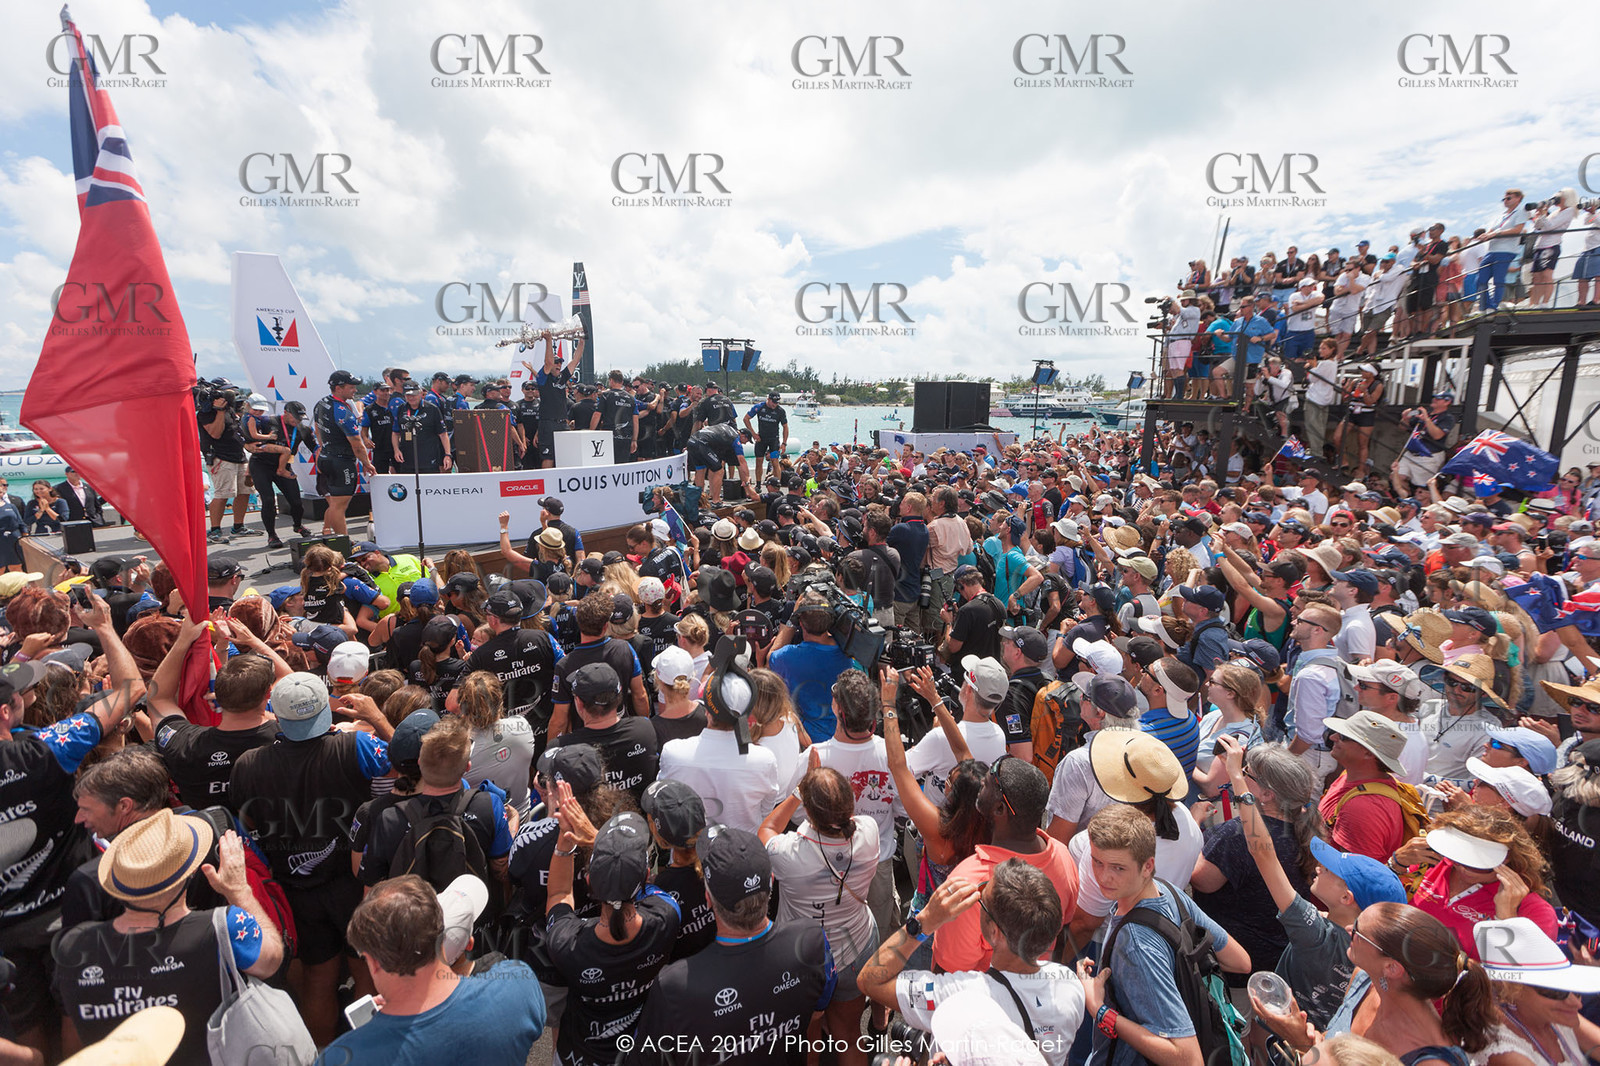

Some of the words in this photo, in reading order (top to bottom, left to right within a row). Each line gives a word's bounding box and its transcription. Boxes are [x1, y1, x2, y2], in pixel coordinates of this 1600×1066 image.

[0, 455, 63, 466] UDA
[559, 475, 607, 493] LOUIS
[612, 468, 661, 486] VUITTON
[426, 487, 484, 496] PANERAI
[512, 660, 524, 669] Fly
[496, 664, 541, 682] Emirates
[1390, 675, 1402, 684] 17
[627, 748, 646, 757] OMEGA
[605, 770, 624, 781] Fly
[1552, 818, 1596, 848] EALAND
[151, 963, 185, 974] OMEGA
[78, 978, 105, 986] TOYOTA
[611, 980, 636, 993] Fly
[773, 977, 801, 995] OMEGA
[114, 986, 143, 1000] Fly
[78, 994, 178, 1020] Emirates
[713, 1002, 743, 1017] TOYOTA
[749, 1012, 775, 1032] Fly
